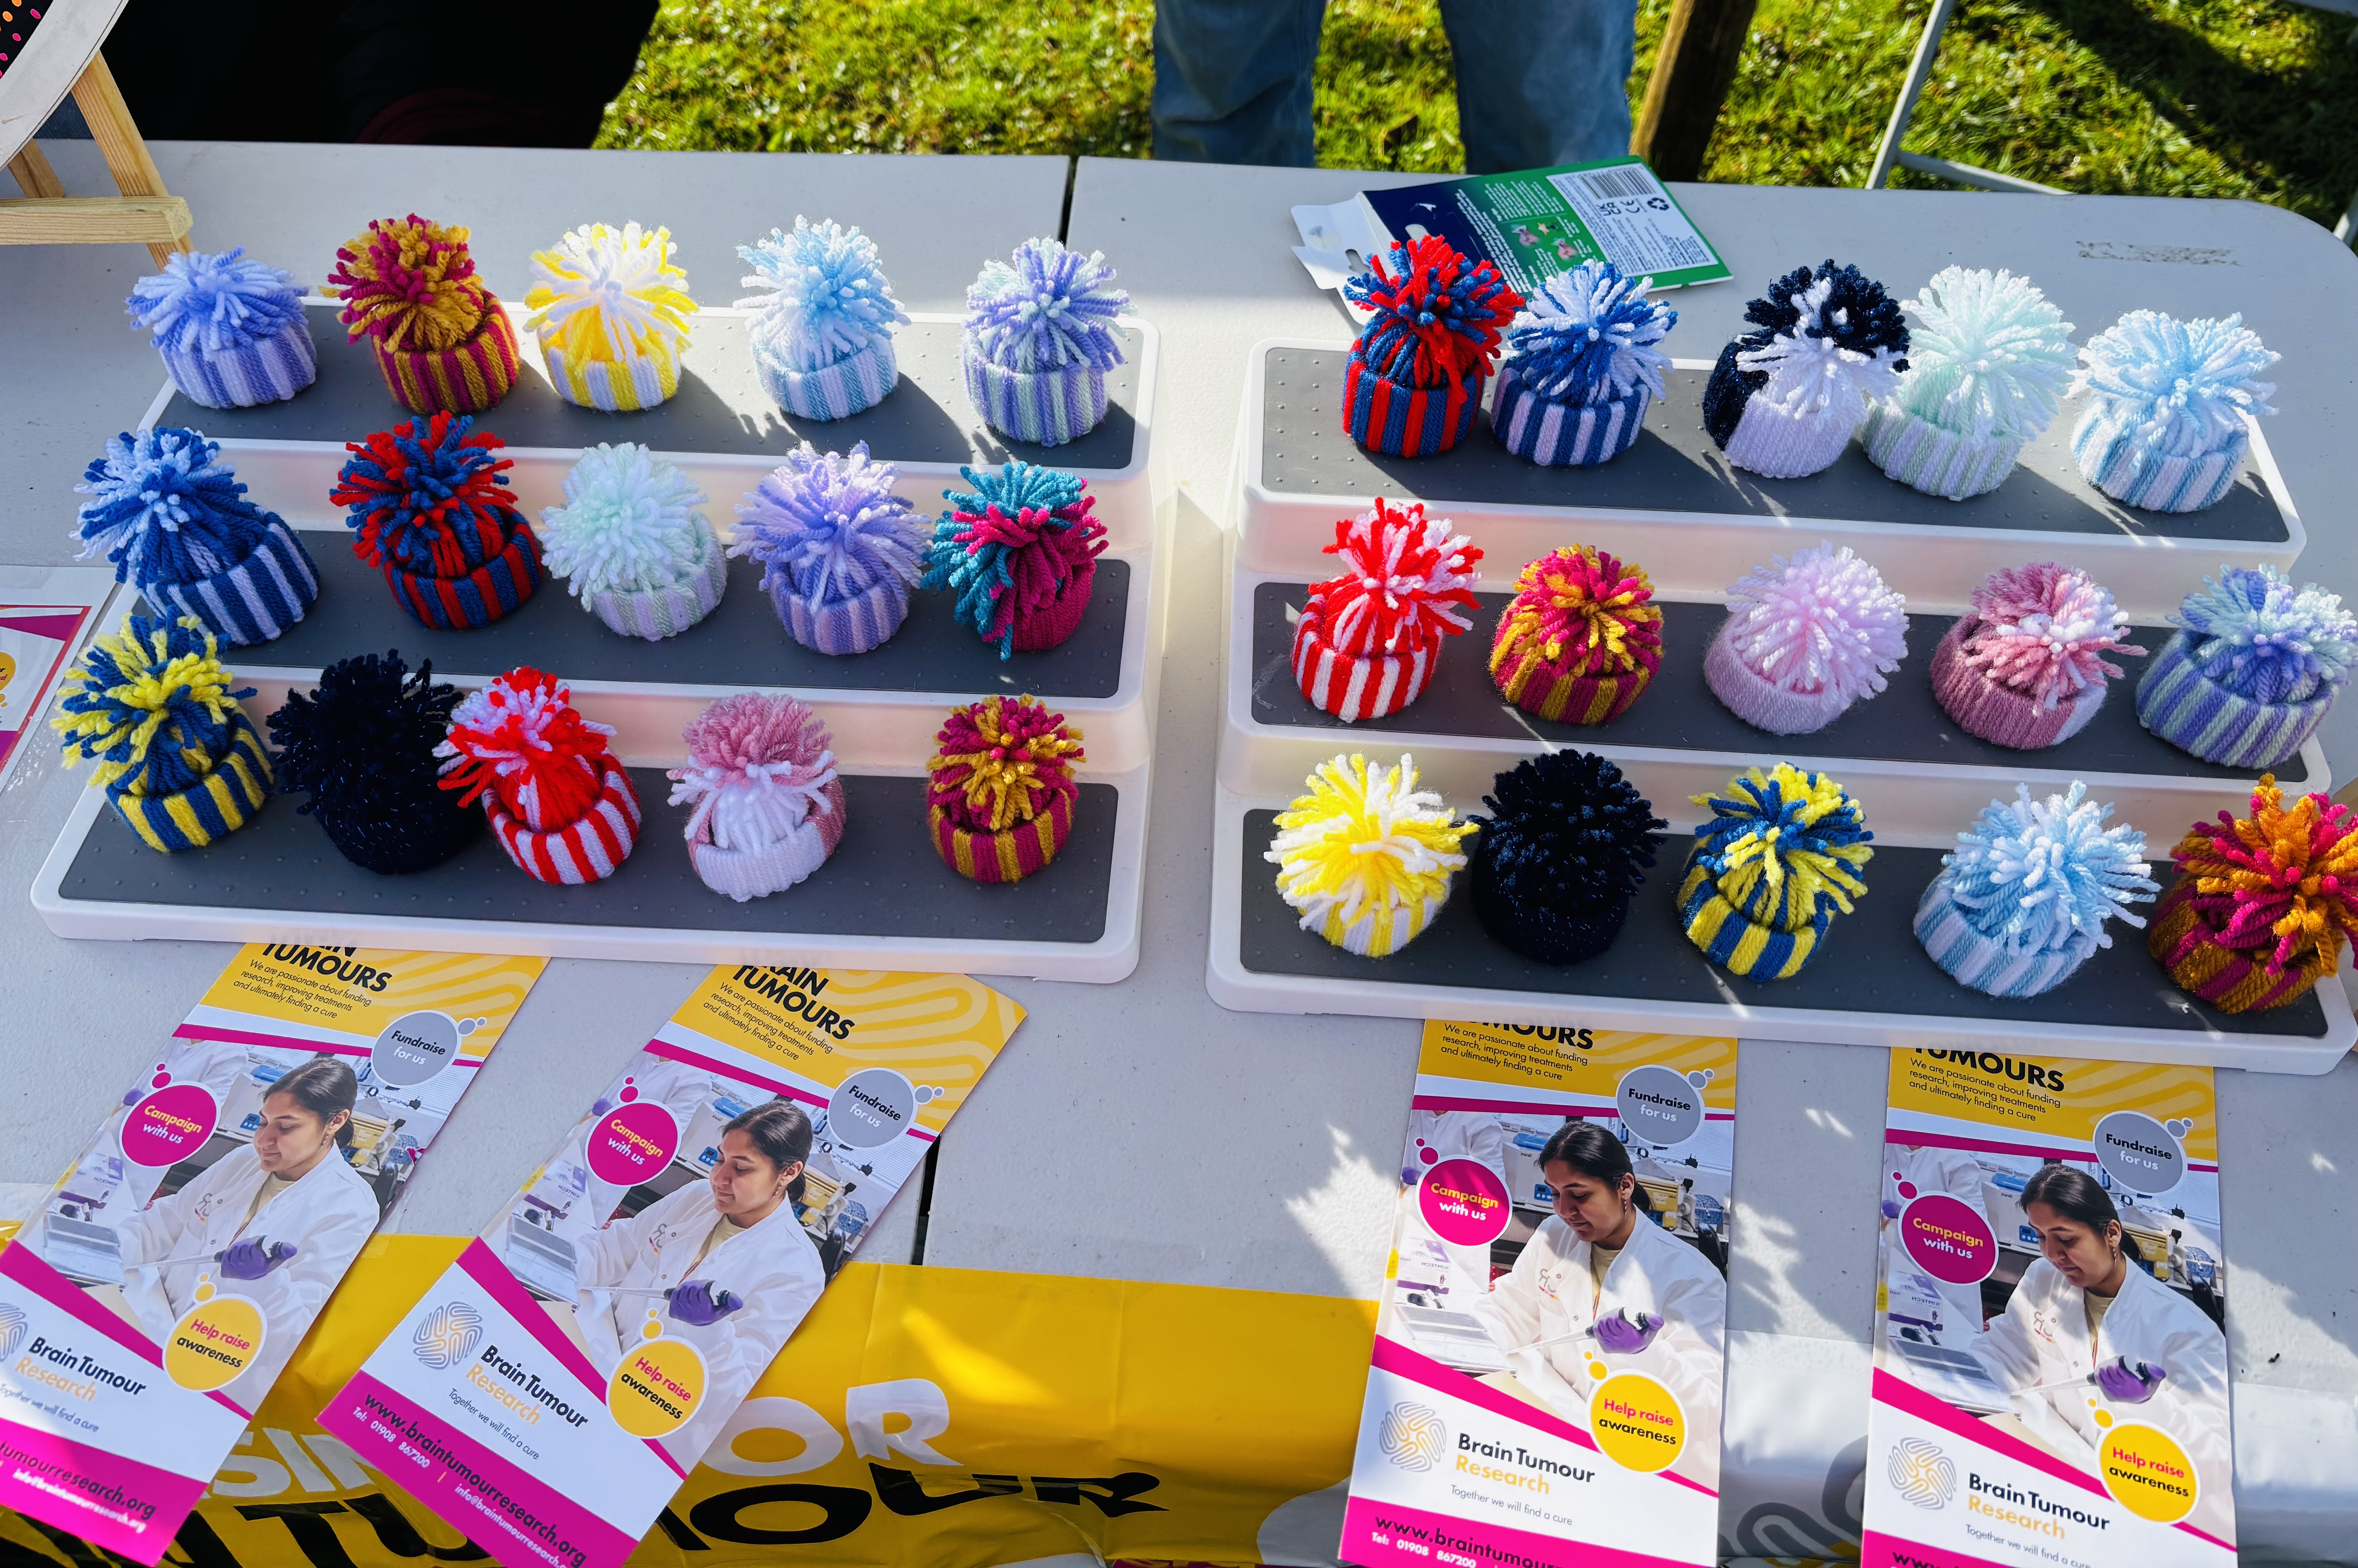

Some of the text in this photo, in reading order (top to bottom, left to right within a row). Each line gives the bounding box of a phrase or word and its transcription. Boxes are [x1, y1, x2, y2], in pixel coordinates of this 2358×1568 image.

[233, 981, 252, 990] and
[250, 984, 286, 1003] ultimately
[285, 995, 313, 1012] finding
[320, 1009, 337, 1018] cure
[241, 971, 353, 1011] research, improving treatments
[250, 959, 264, 970] We
[276, 971, 319, 988] passionate
[319, 983, 343, 995] about
[342, 989, 372, 1007] funding
[765, 966, 829, 997] AIN
[720, 982, 833, 1054] We are passionate about funding
[733, 965, 855, 1040] TUMOURS
[391, 1030, 445, 1055] Fundraise
[703, 1002, 721, 1013] and
[718, 1010, 752, 1033] ultimately
[751, 1027, 776, 1048] finding
[783, 1048, 799, 1060] cure
[711, 993, 814, 1055] research, improving treatments
[393, 1046, 426, 1064] for us
[1441, 1047, 1459, 1055] and
[1461, 1049, 1501, 1067] ultimately
[1503, 1058, 1533, 1075] finding
[1544, 1071, 1563, 1080] cure
[1442, 1036, 1573, 1071] research, improving treatments
[1444, 1023, 1460, 1034] We
[1479, 1034, 1525, 1049] passionate
[1527, 1043, 1553, 1056] about
[1555, 1049, 1588, 1066] funding
[1629, 1088, 1691, 1111] Fundraise
[1909, 1081, 1927, 1090] and
[1930, 1085, 1972, 1105] ultimately
[1974, 1096, 2005, 1115] finding
[2016, 1111, 2036, 1121] cure
[1910, 1057, 2060, 1108] We are passionate about funding
[1910, 1071, 2046, 1113] research, improving treatments
[144, 1105, 202, 1133] Campaign
[848, 1085, 901, 1120] Fundraise
[849, 1103, 881, 1127] for us
[1640, 1104, 1676, 1122] for us
[143, 1123, 184, 1144] with us
[608, 1137, 645, 1165] with us
[611, 1119, 663, 1157] Campaign
[2106, 1133, 2172, 1160] Fundraise
[2120, 1150, 2158, 1170] for us
[1431, 1183, 1498, 1208] Campaign
[1439, 1202, 1486, 1220] with us
[1913, 1217, 1983, 1247] Campaign
[1923, 1238, 1972, 1259] with us
[177, 1337, 243, 1368] awareness
[190, 1319, 250, 1350] Help raise
[15, 1357, 95, 1401] Research
[28, 1336, 147, 1395] Brain Tumour
[635, 1357, 691, 1401] Help raise
[466, 1364, 540, 1425] Research
[481, 1345, 589, 1428] Brain Tumour
[621, 1374, 683, 1419] awareness
[449, 1388, 479, 1414] Together
[478, 1412, 489, 1423] we
[490, 1420, 504, 1432] will
[501, 1427, 519, 1443] find
[523, 1445, 539, 1459] cure
[1604, 1398, 1674, 1426] Help raise
[352, 1406, 367, 1422] Tel:
[370, 1420, 396, 1442] 01908
[398, 1441, 430, 1468] 867200
[1599, 1419, 1676, 1445] awareness
[1455, 1453, 1550, 1495] Research
[1458, 1432, 1596, 1483] Brain Tumour
[2113, 1447, 2184, 1478] Help raise
[0, 1441, 156, 1520] tumourresearch.org
[365, 1394, 587, 1568] www.braintumourresearch.org
[2109, 1467, 2189, 1497] awareness
[1451, 1484, 1489, 1503] Together
[1492, 1498, 1504, 1507] we
[1507, 1502, 1522, 1512] will
[1524, 1504, 1541, 1517] find
[1553, 1515, 1572, 1525] cure
[1968, 1494, 2065, 1540] Research
[1969, 1473, 2110, 1530] Brain Tumour
[1371, 1532, 1476, 1568] Tel: 01908 867200
[1965, 1524, 2005, 1544] Together
[2008, 1540, 2021, 1550] we
[2024, 1545, 2038, 1555] will
[2041, 1547, 2059, 1562] find
